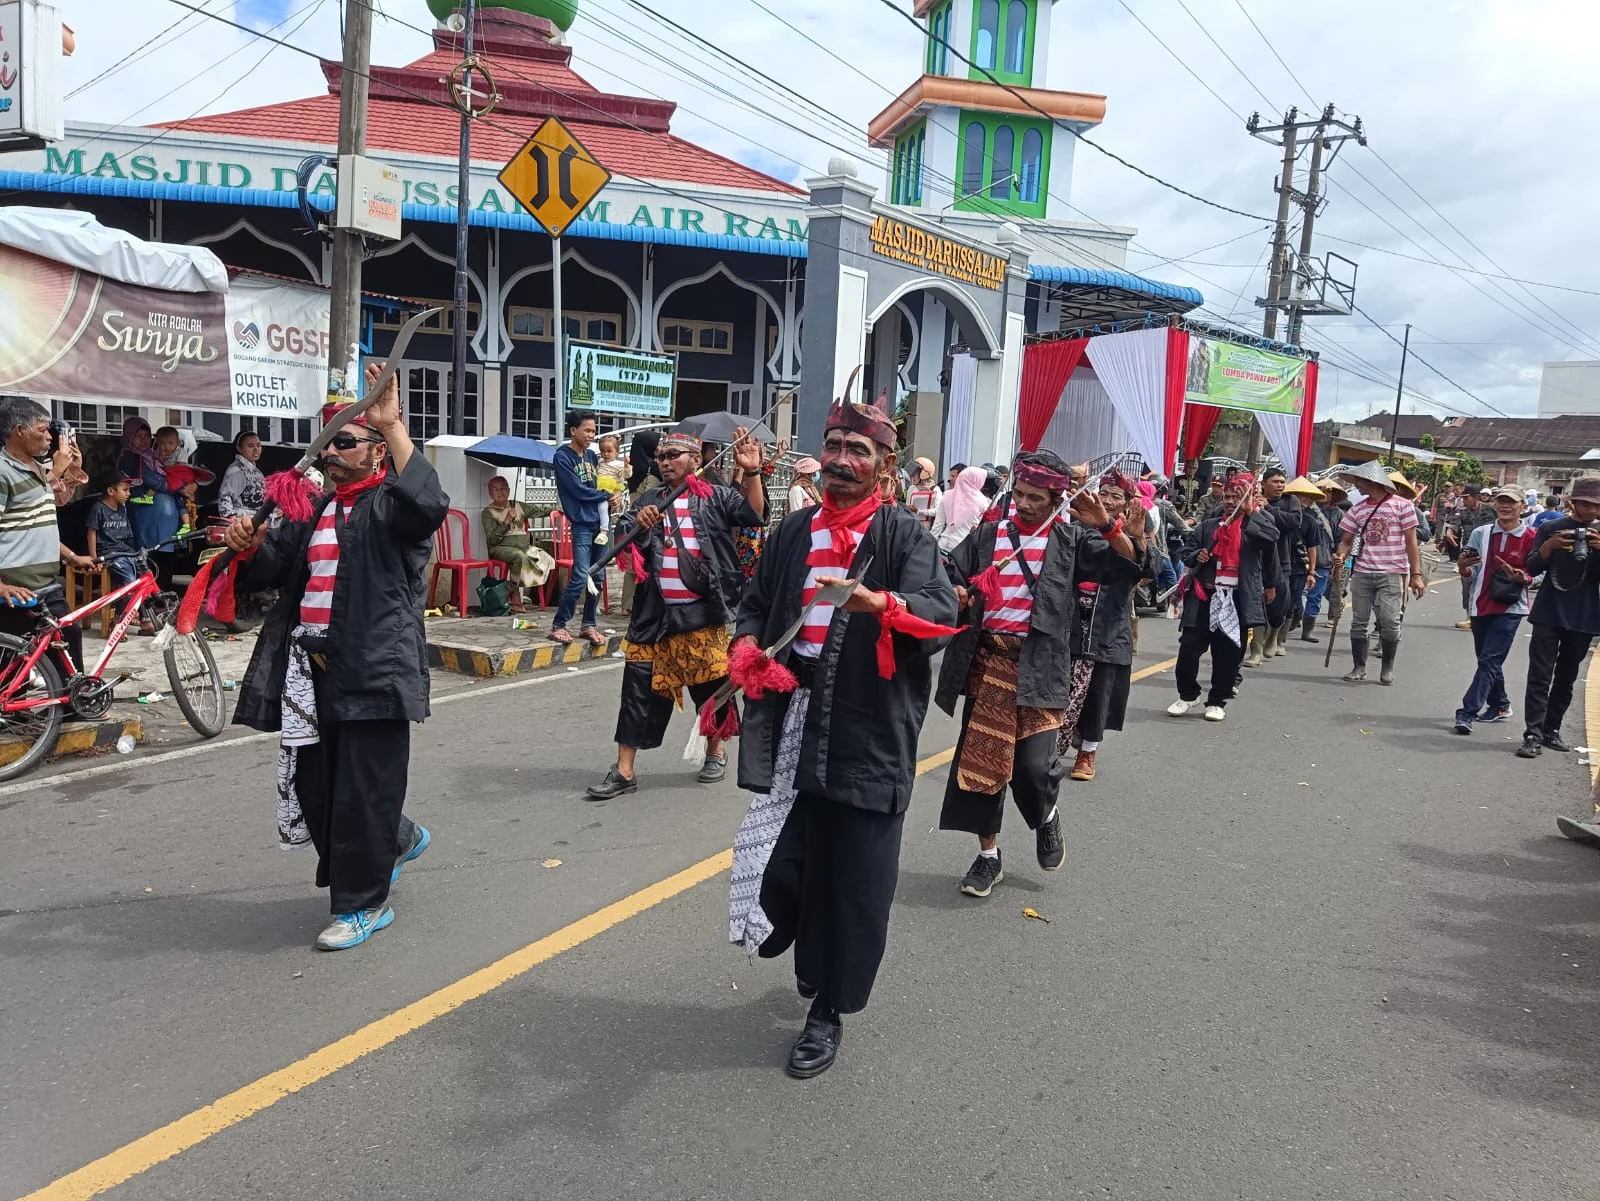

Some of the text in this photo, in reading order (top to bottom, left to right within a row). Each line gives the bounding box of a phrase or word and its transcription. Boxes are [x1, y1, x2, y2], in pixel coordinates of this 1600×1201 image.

[43, 147, 252, 188] MASJID
[628, 205, 706, 233] AIR
[870, 216, 1006, 282] MASJID DARUSSALAM
[873, 244, 1000, 290] KELURAHAN AIR RAMBAI CURUP
[148, 312, 202, 333] KITA ADALAH
[97, 310, 218, 373] Surya
[276, 359, 303, 368] STRATEGIC
[235, 373, 286, 391] OUTLET
[236, 391, 298, 410] KRISTIAN
